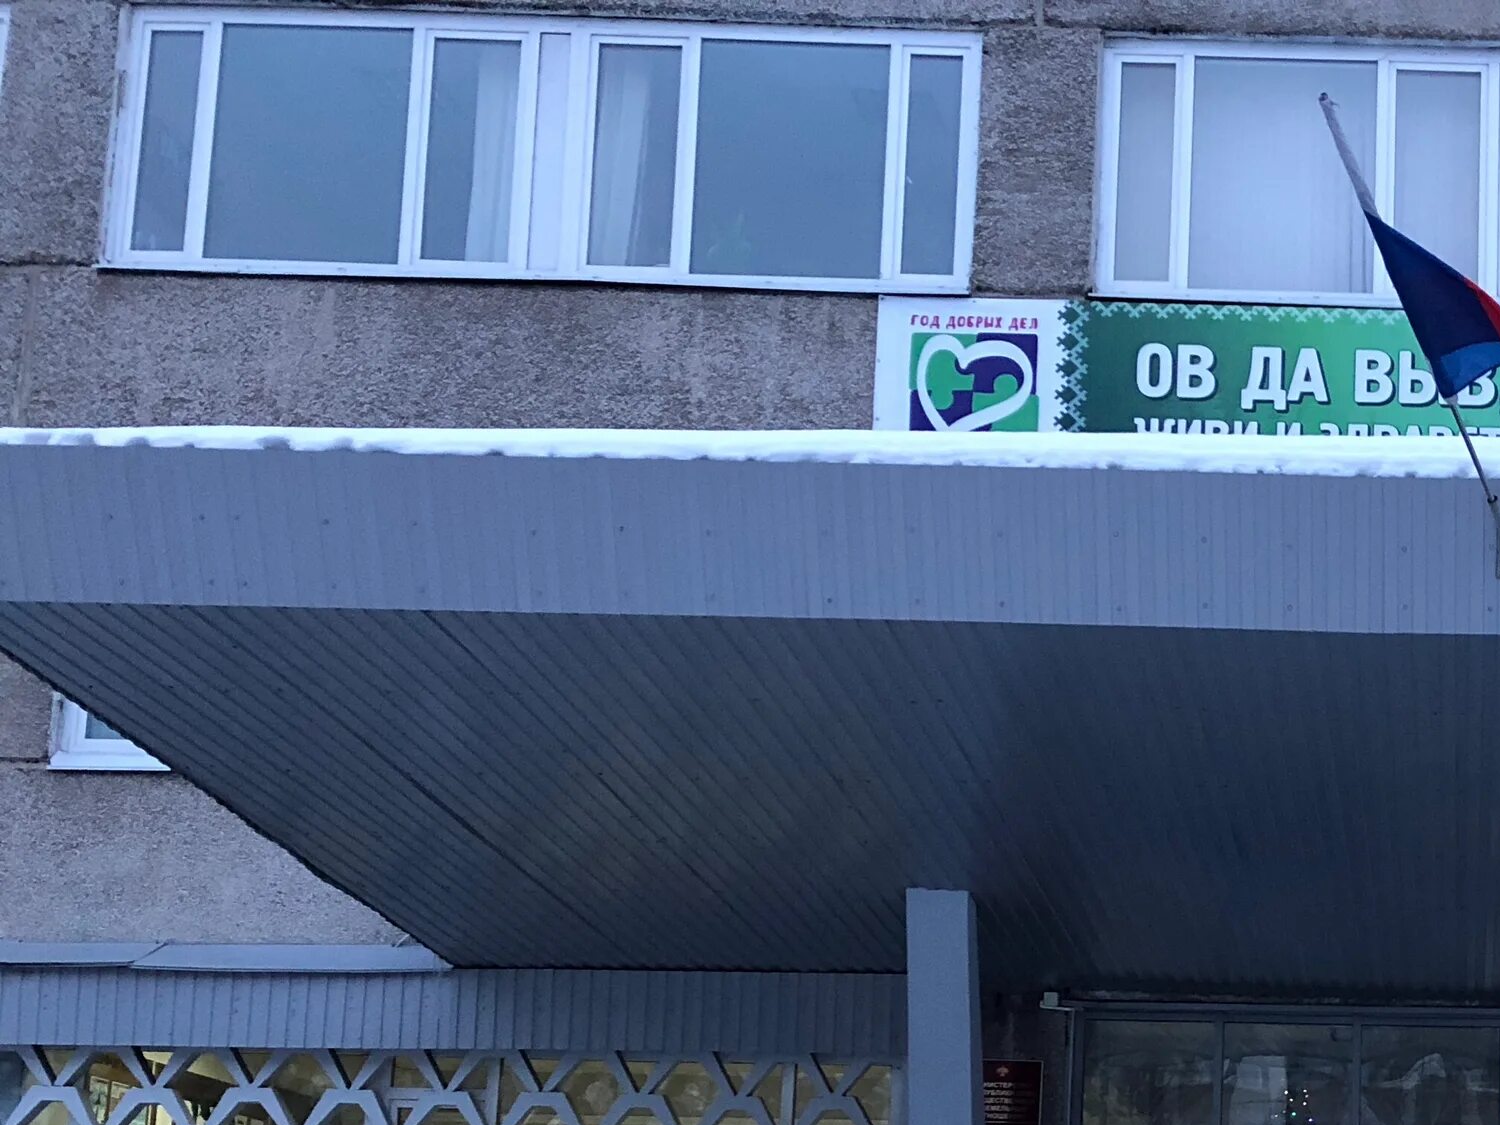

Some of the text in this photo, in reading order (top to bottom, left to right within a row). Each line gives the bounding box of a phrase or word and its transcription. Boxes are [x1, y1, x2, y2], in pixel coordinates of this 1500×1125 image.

[910, 314, 1038, 331] ГОД ДОБРЫХ ДЕЛ
[1136, 342, 1216, 399] ОВ
[1241, 346, 1328, 411] ДА
